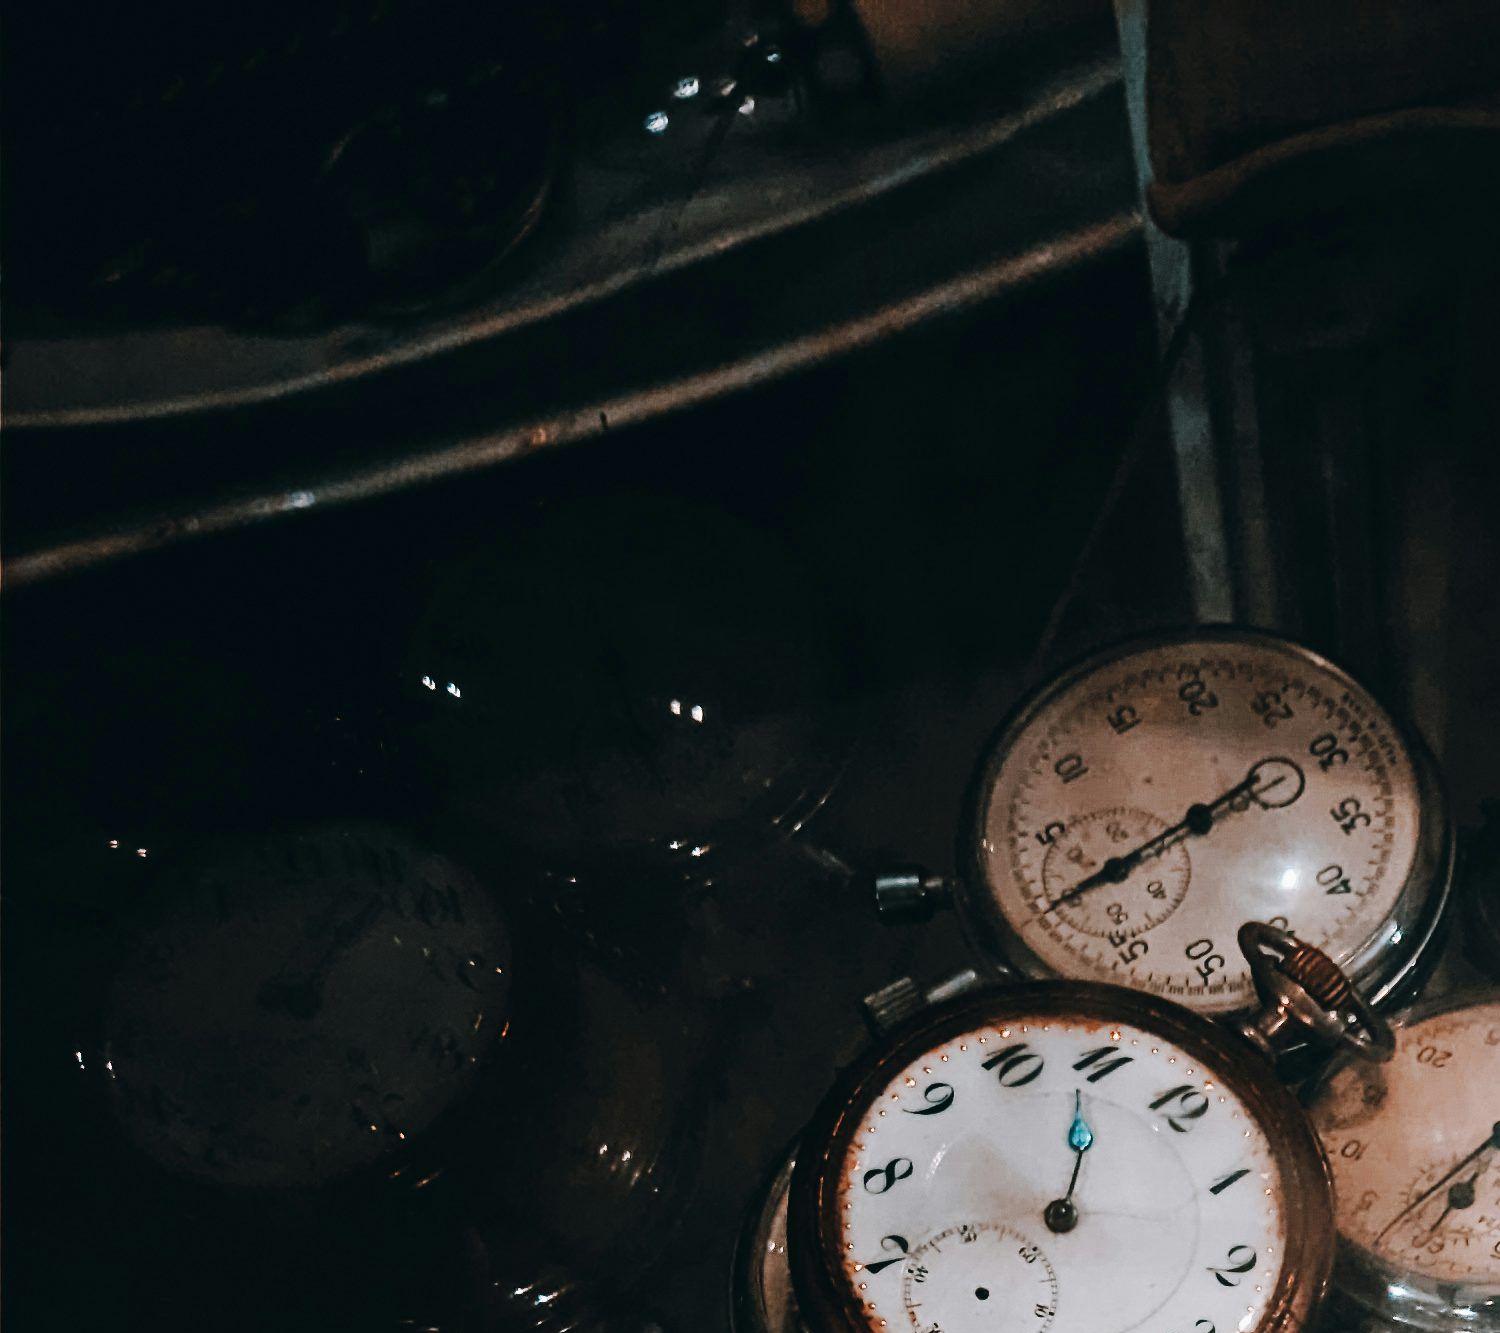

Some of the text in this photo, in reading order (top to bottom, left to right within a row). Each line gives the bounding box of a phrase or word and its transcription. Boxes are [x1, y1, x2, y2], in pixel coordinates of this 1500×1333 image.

[1330, 798, 1371, 835] 35
[1316, 865, 1352, 897] 40
[1186, 938, 1225, 980] 50
[981, 1043, 1044, 1088] 10
[1072, 1046, 1134, 1082] 11
[1417, 1046, 1452, 1068] 20
[902, 1082, 954, 1115] 9
[1148, 1085, 1209, 1132] 12
[863, 1157, 914, 1194] 8
[1208, 1168, 1251, 1195] 1
[864, 1234, 909, 1274] 7
[1206, 1245, 1257, 1286] 2
